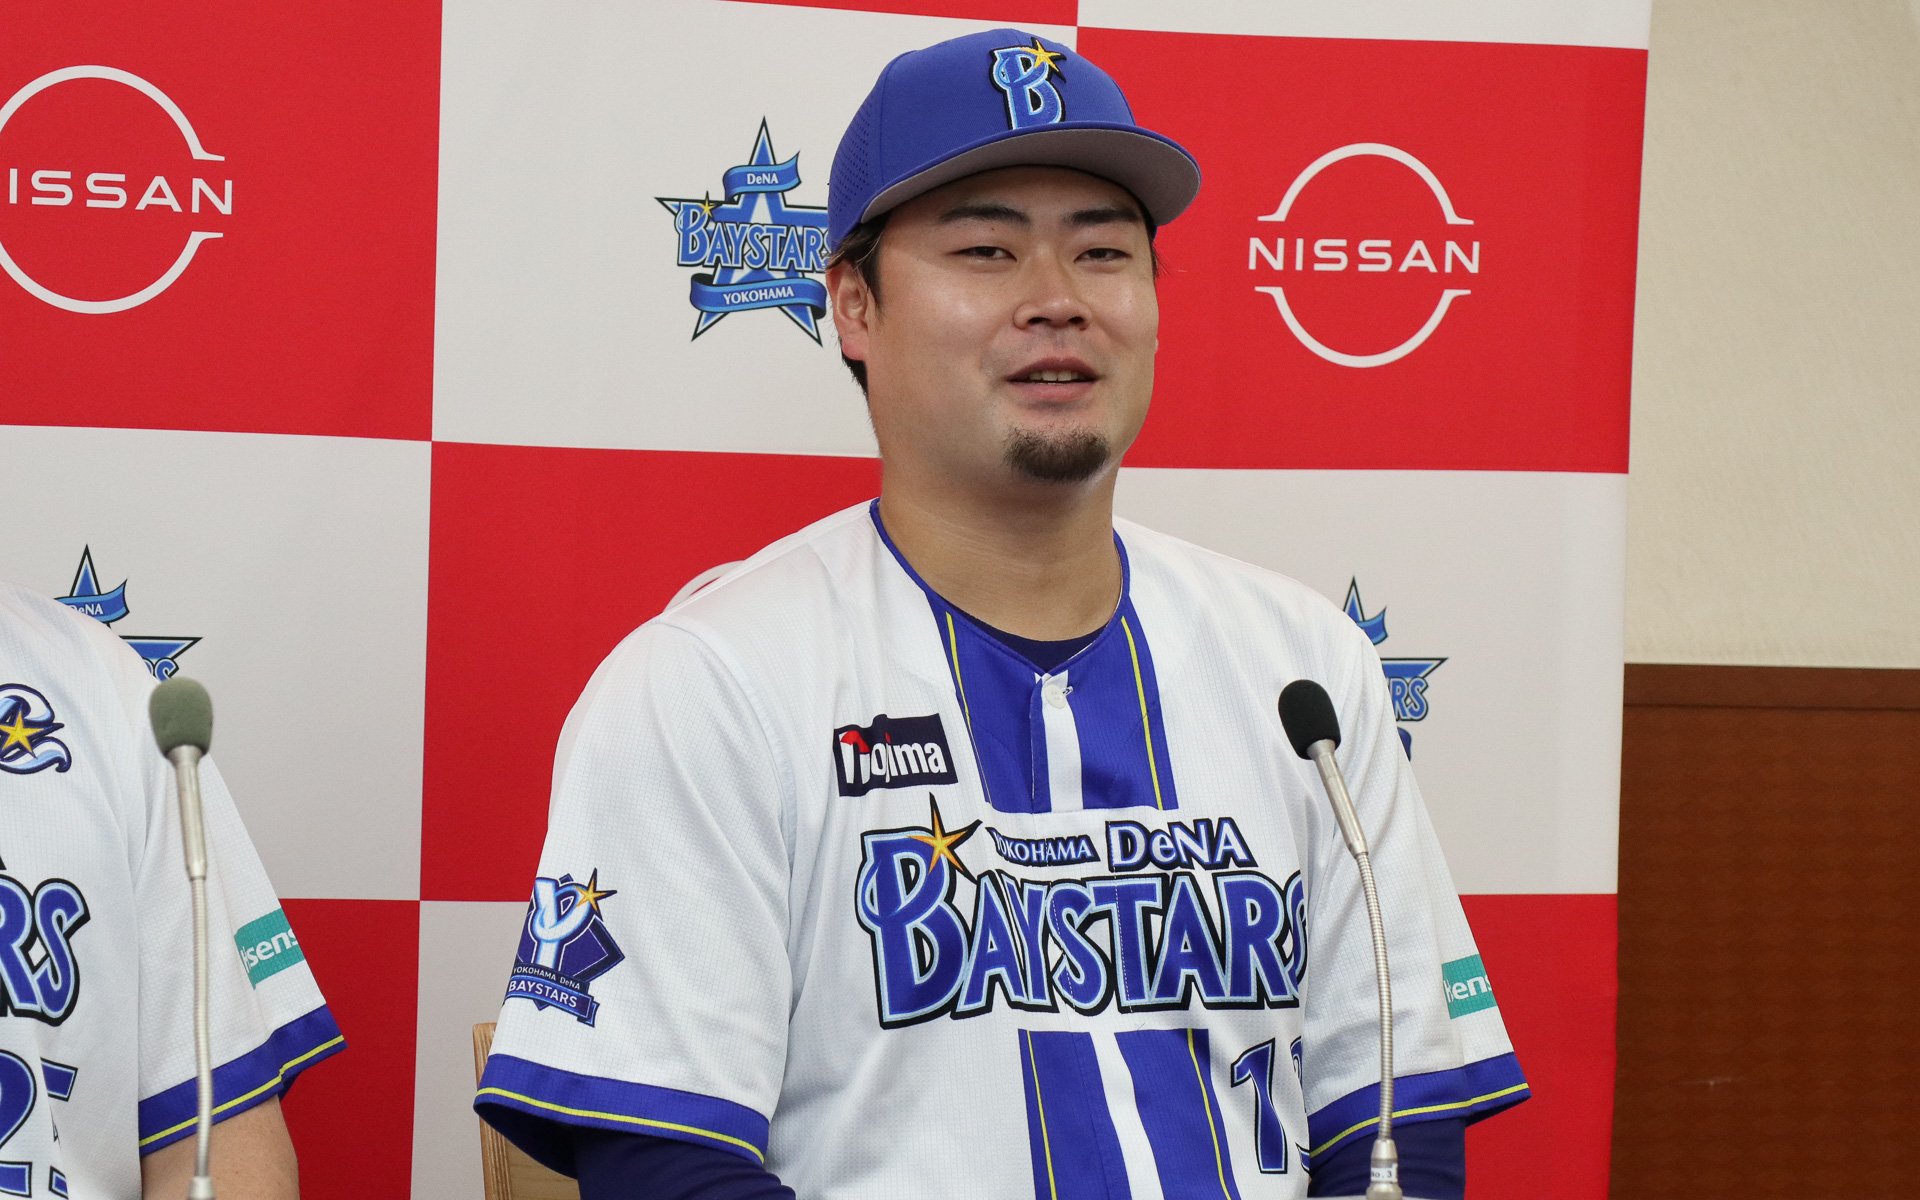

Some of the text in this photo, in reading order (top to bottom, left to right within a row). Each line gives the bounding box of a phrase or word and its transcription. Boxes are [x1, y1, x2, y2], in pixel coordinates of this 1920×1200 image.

[746, 172, 779, 185] DeNA
[1248, 237, 1480, 274] NISSAN
[723, 285, 795, 305] YOKOHAMA
[1105, 817, 1258, 872] DeNA
[508, 980, 577, 1008] BAYSTARS
[560, 976, 580, 991] DeNA
